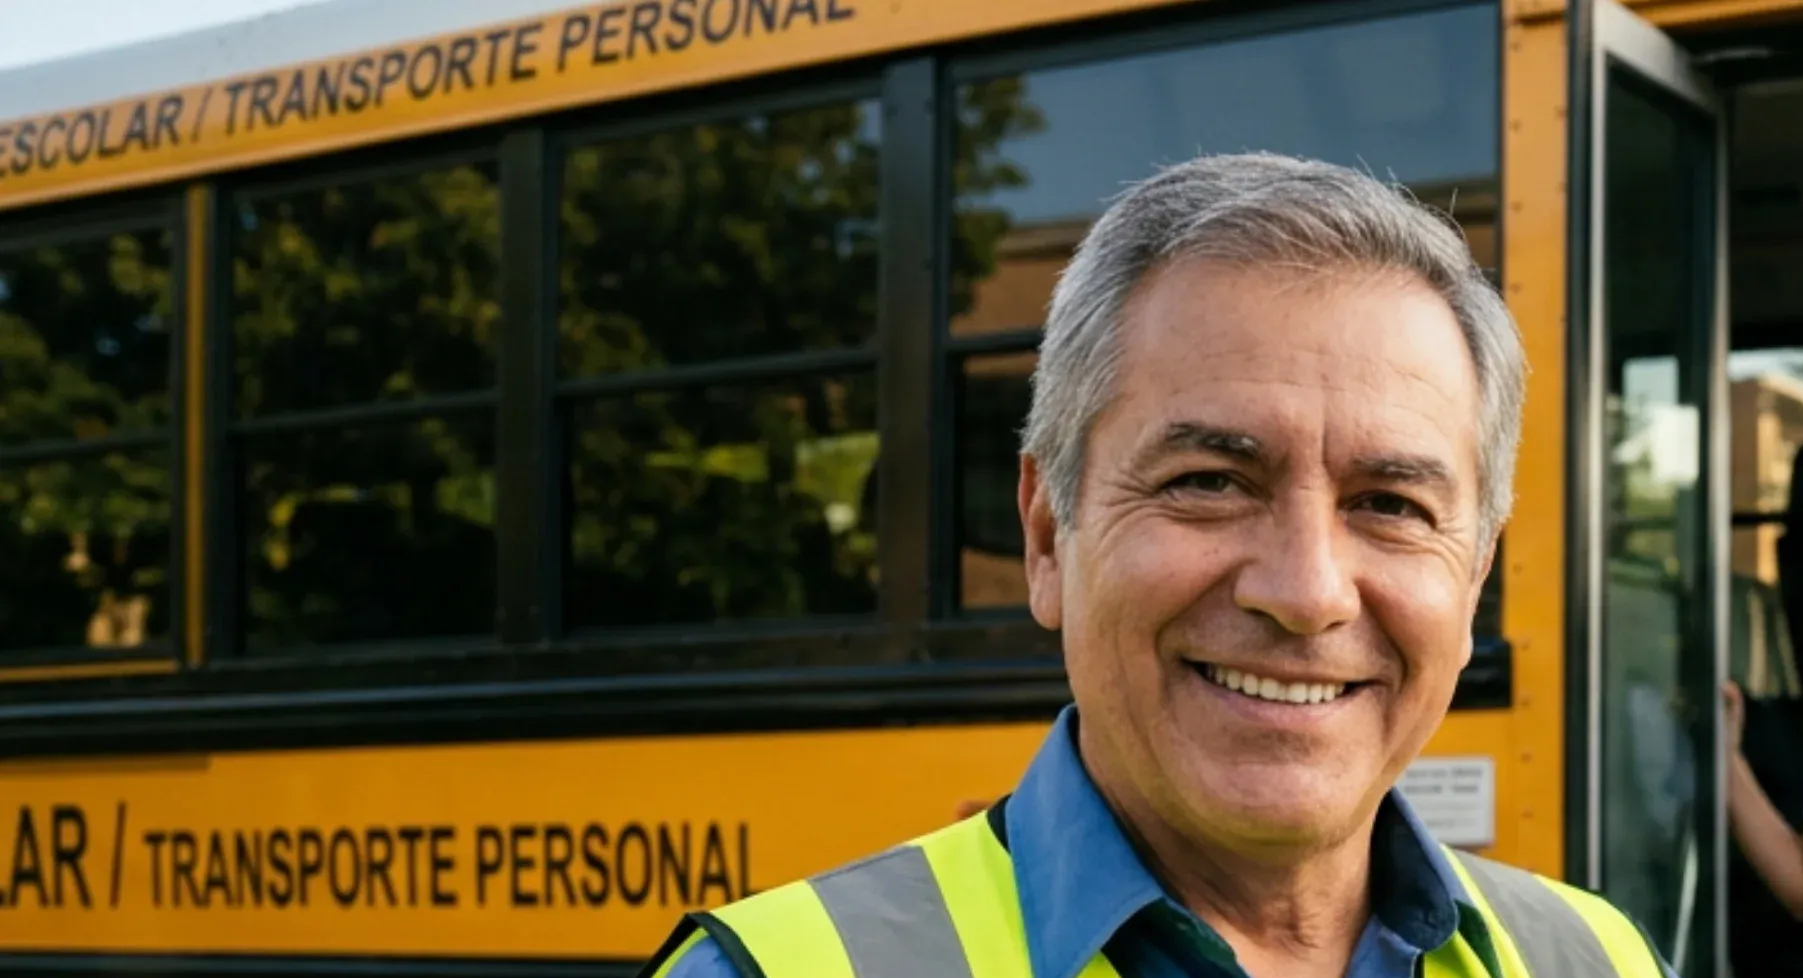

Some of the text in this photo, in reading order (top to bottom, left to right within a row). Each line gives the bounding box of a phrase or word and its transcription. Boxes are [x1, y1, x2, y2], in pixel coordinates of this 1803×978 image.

[190, 85, 213, 144] /
[223, 21, 544, 136] TRANSPORTE
[0, 798, 757, 910] AR / TRANSPORTE PERSONAL
